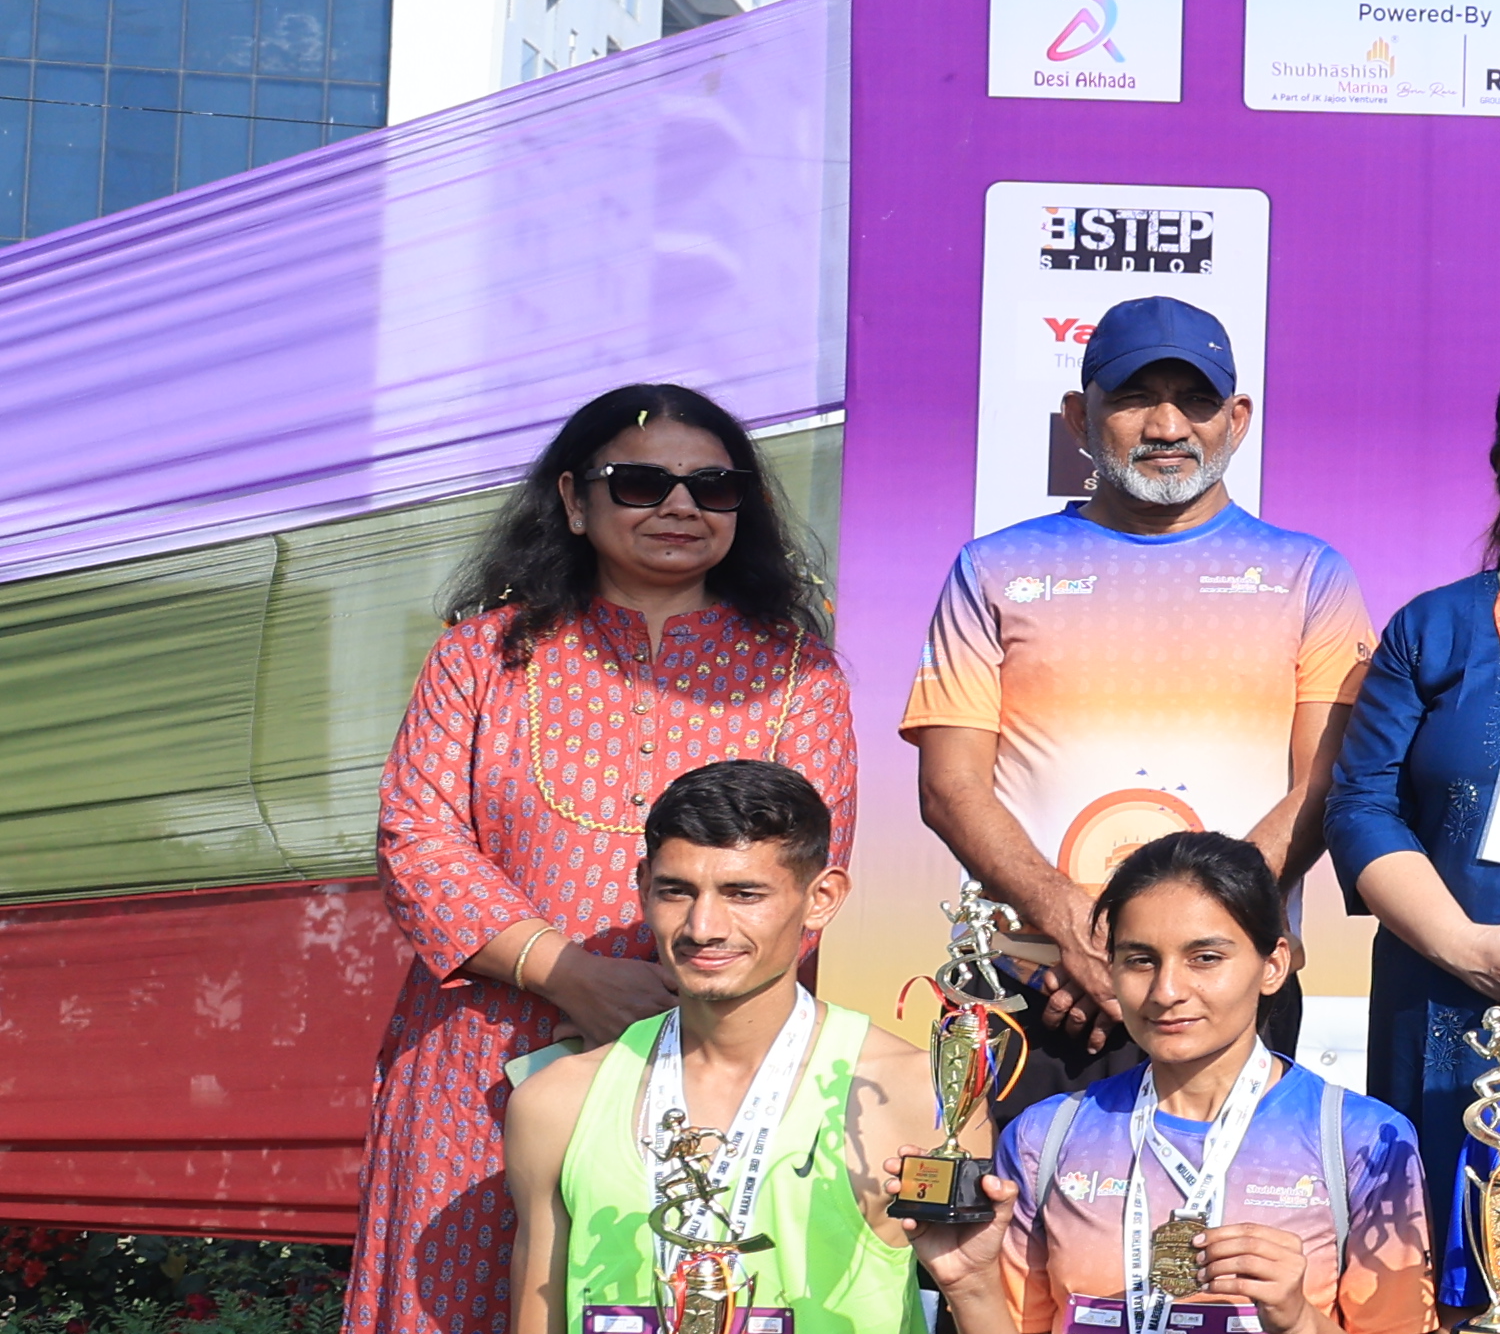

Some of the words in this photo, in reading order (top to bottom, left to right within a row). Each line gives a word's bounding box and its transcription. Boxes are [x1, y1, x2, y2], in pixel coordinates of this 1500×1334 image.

[1358, 3, 1493, 27] Powered-By
[1033, 71, 1070, 88] Desi
[1075, 72, 1137, 89] Akhada
[1337, 80, 1389, 95] Marina
[1280, 94, 1299, 103] Part
[1301, 94, 1311, 103] of
[1348, 96, 1388, 105] Ventures
[1039, 255, 1213, 275] STUDIOS
